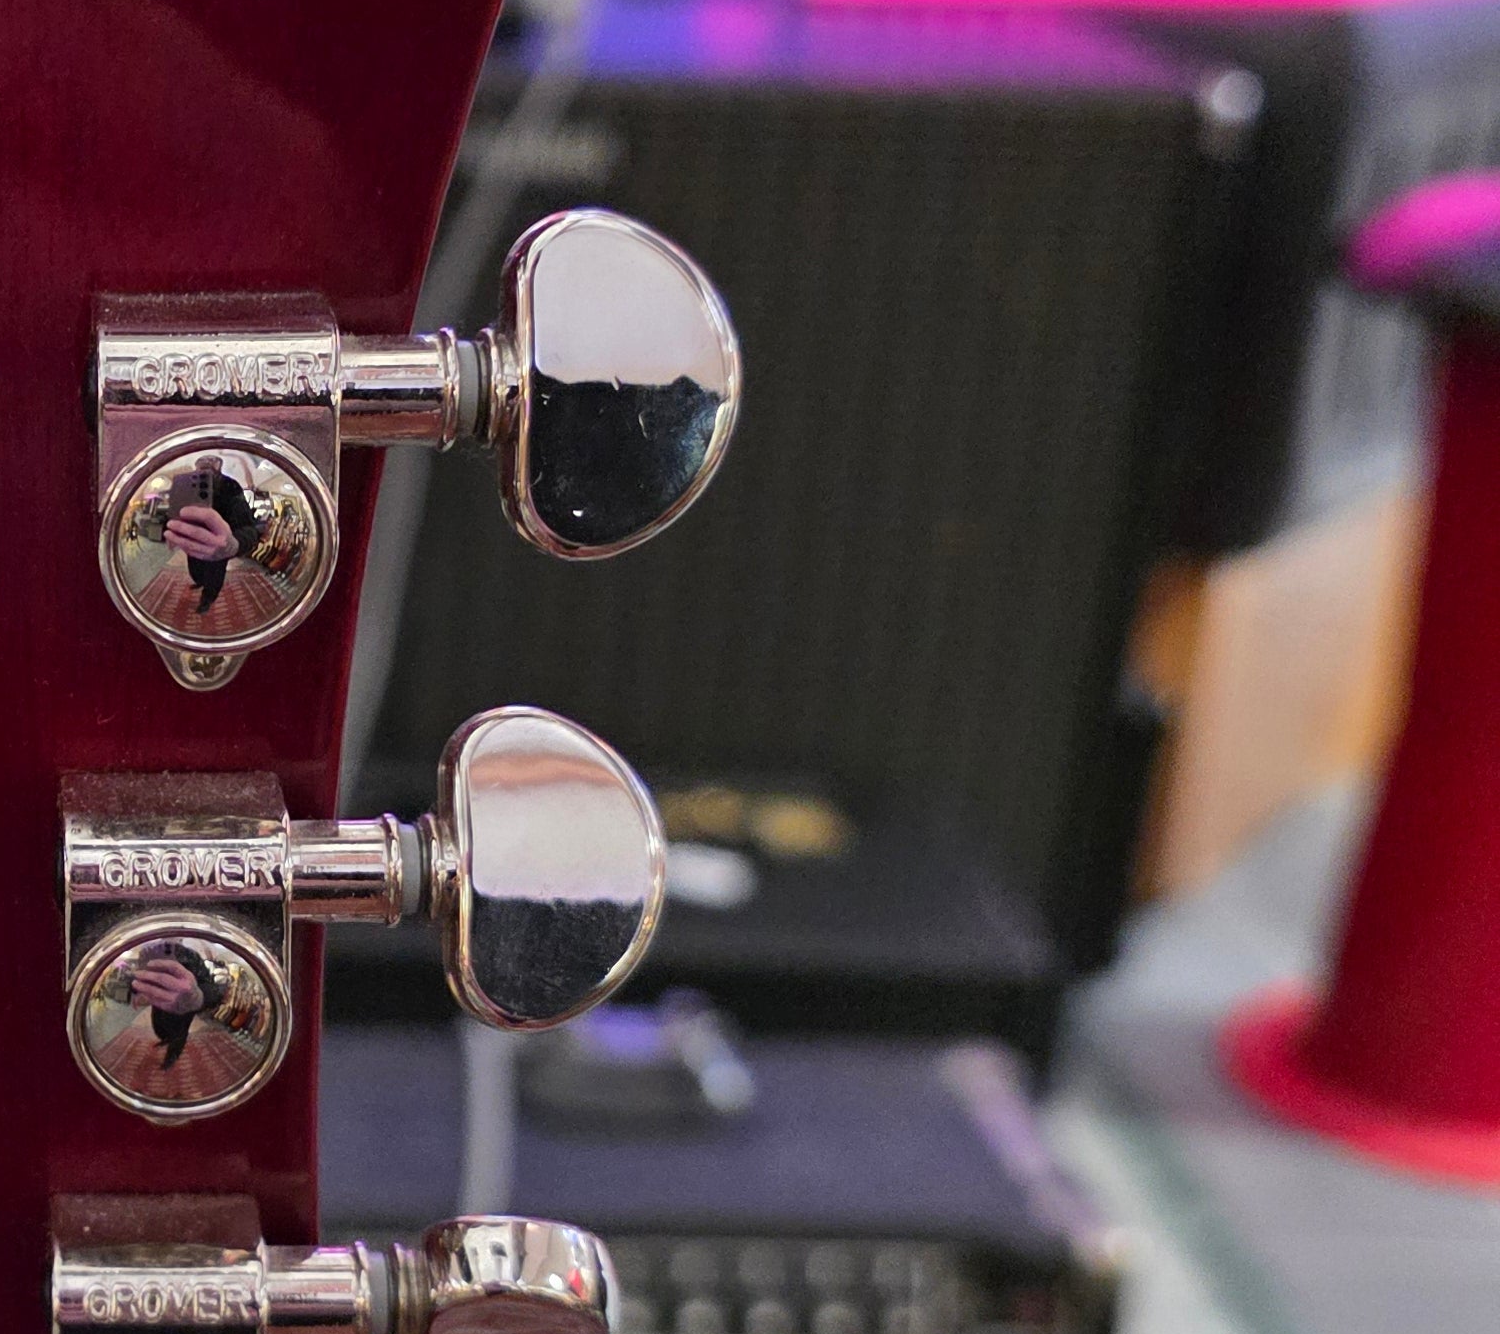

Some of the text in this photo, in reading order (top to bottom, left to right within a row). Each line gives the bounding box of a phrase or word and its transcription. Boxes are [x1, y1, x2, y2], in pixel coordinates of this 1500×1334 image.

[132, 353, 322, 402] GROVER
[100, 848, 276, 892] GROVER
[85, 1281, 250, 1323] GROVER
